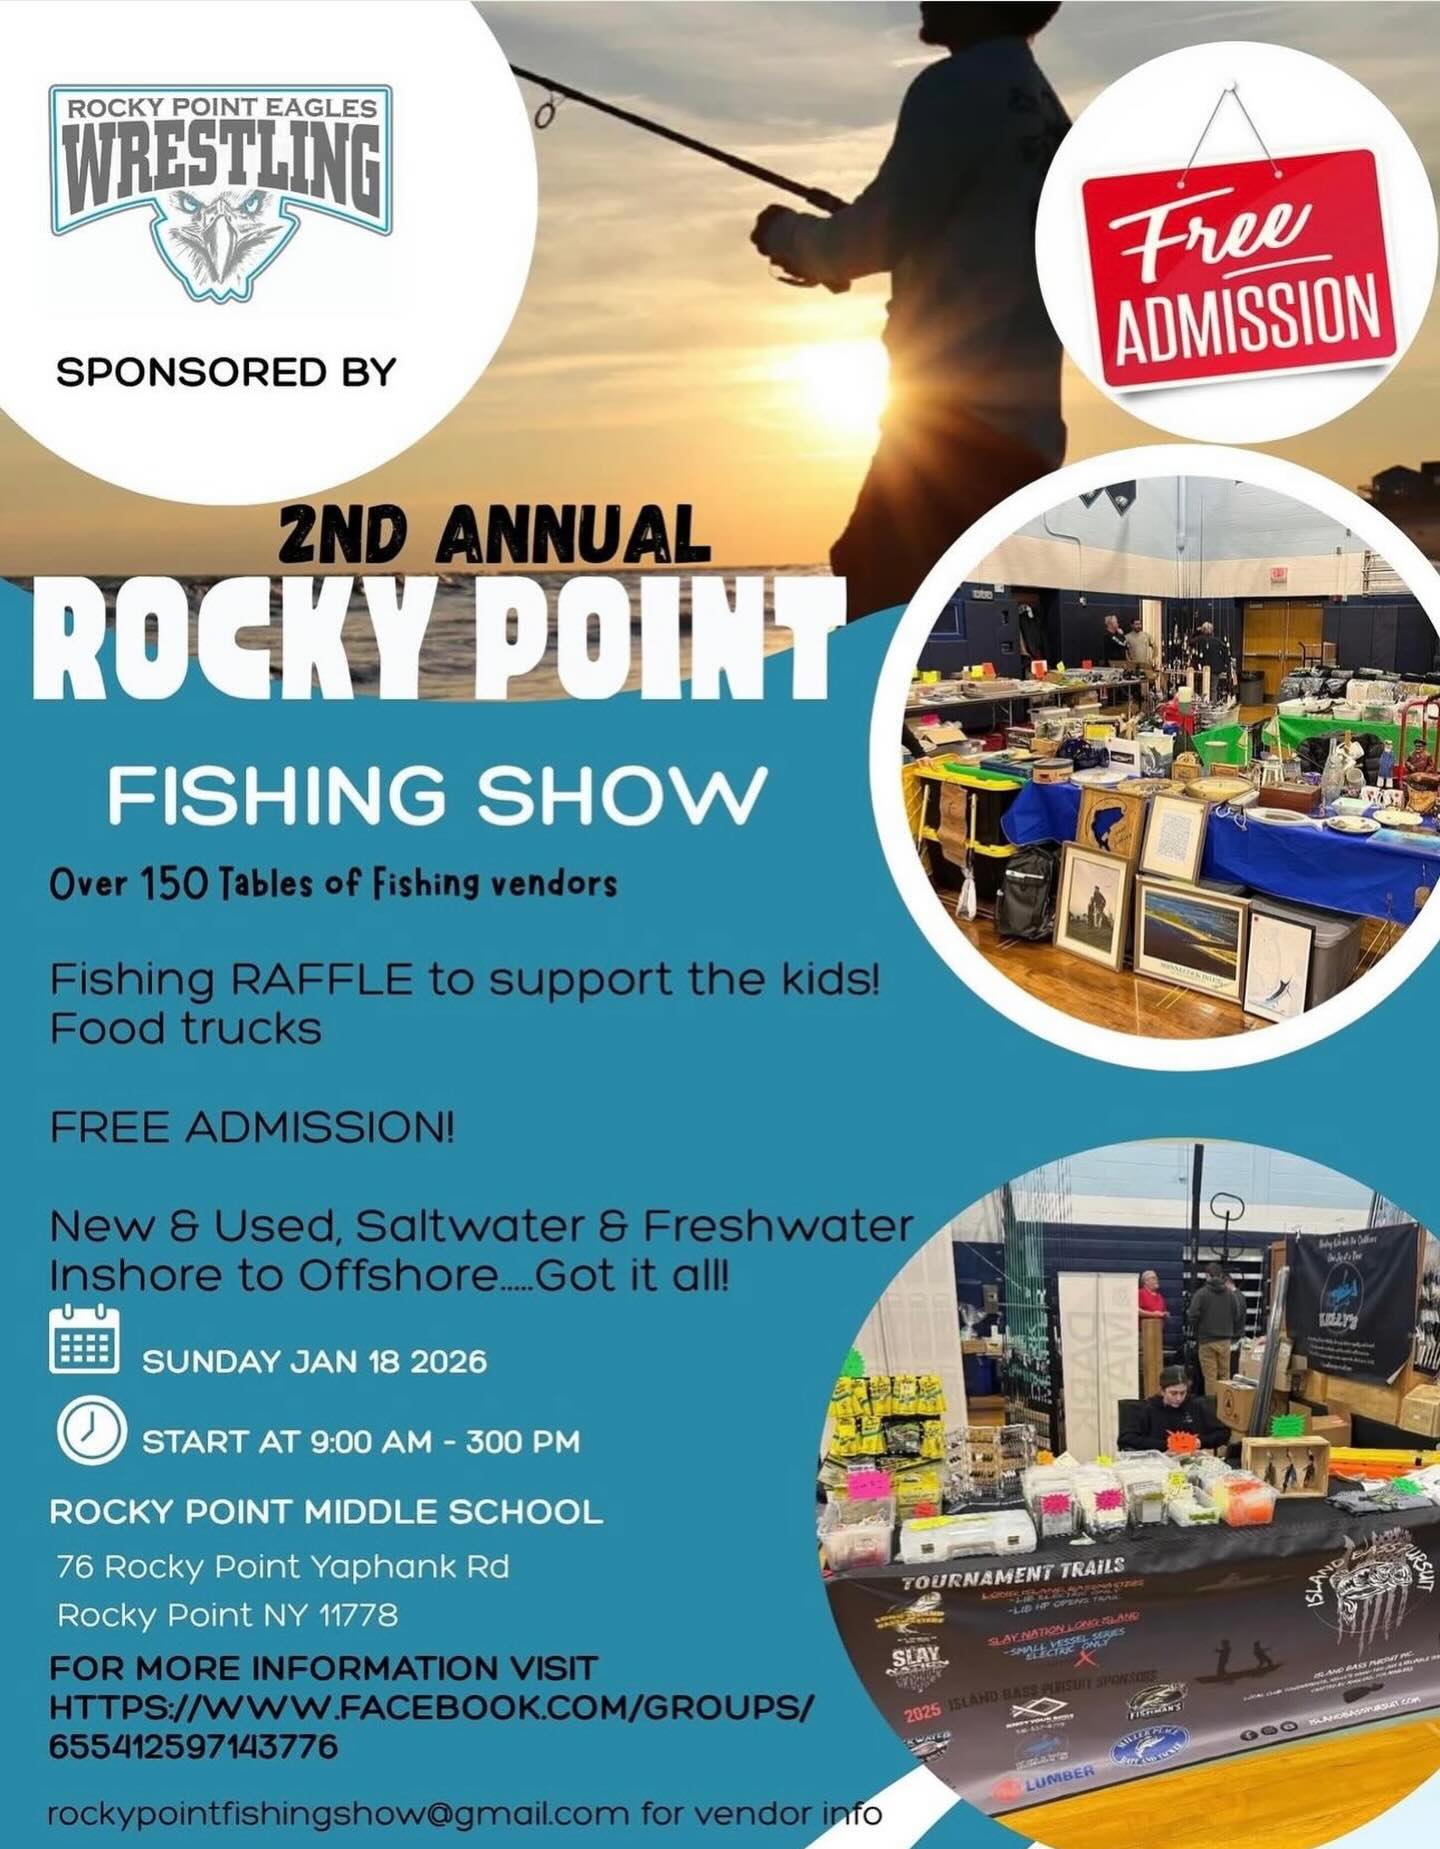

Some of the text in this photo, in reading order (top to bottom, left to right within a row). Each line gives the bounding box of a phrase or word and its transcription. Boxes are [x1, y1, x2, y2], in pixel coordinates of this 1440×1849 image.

[68, 97, 378, 119] ROCKY POINT EAGLES
[62, 118, 380, 218] WRESTLING
[1109, 187, 1313, 284] Free
[1116, 272, 1381, 367] ADMISSION
[57, 357, 397, 387] SPONSORED BY
[279, 504, 711, 564] 2ND ANNUAL
[33, 576, 847, 700] ROCKY POINT
[110, 765, 768, 827] FISHING SHOW
[50, 865, 616, 900] Over 150 Tables of Fishing vendors
[52, 962, 878, 1004] Fishing RAFFLE to support the kids!
[53, 1011, 321, 1044] Food trucks
[53, 1111, 453, 1143] FREE ADMISSION!
[52, 1209, 913, 1245] New & Used, Saltwater & Freshwater
[52, 1258, 221, 1291] Inshore
[238, 1259, 283, 1291] to
[633, 1259, 657, 1291] it
[674, 1258, 727, 1291] all!
[143, 1349, 487, 1374] SUNDAY JAN 18 2026
[143, 1430, 249, 1454] START
[260, 1430, 301, 1454] AT
[311, 1430, 372, 1454] 9:00
[382, 1430, 431, 1453] AM
[467, 1430, 522, 1454] 300
[534, 1430, 579, 1453] PM
[51, 1499, 603, 1525] ROCKY POINT MIDDLE SCHOOL
[57, 1554, 509, 1585] 76 Rocky Point Yaphank Rd
[902, 1564, 1055, 1590] TOURNAMENT
[1305, 1558, 1344, 1607] ISLAND
[59, 1603, 398, 1633] Rocky Point NY 11778
[51, 1656, 598, 1681] FOR MORE INFORMATION VISIT
[892, 1646, 940, 1667] SLAY
[51, 1694, 815, 1723] HTTPS://WWW.FACEBOOK.COM/GROUPS/
[904, 1702, 942, 1723] 2025
[50, 1734, 337, 1761] 655412597143776
[1025, 1764, 1095, 1792] LUMBER
[48, 1801, 883, 1832] rockypointfishingshow@gmail.com for vendor info
